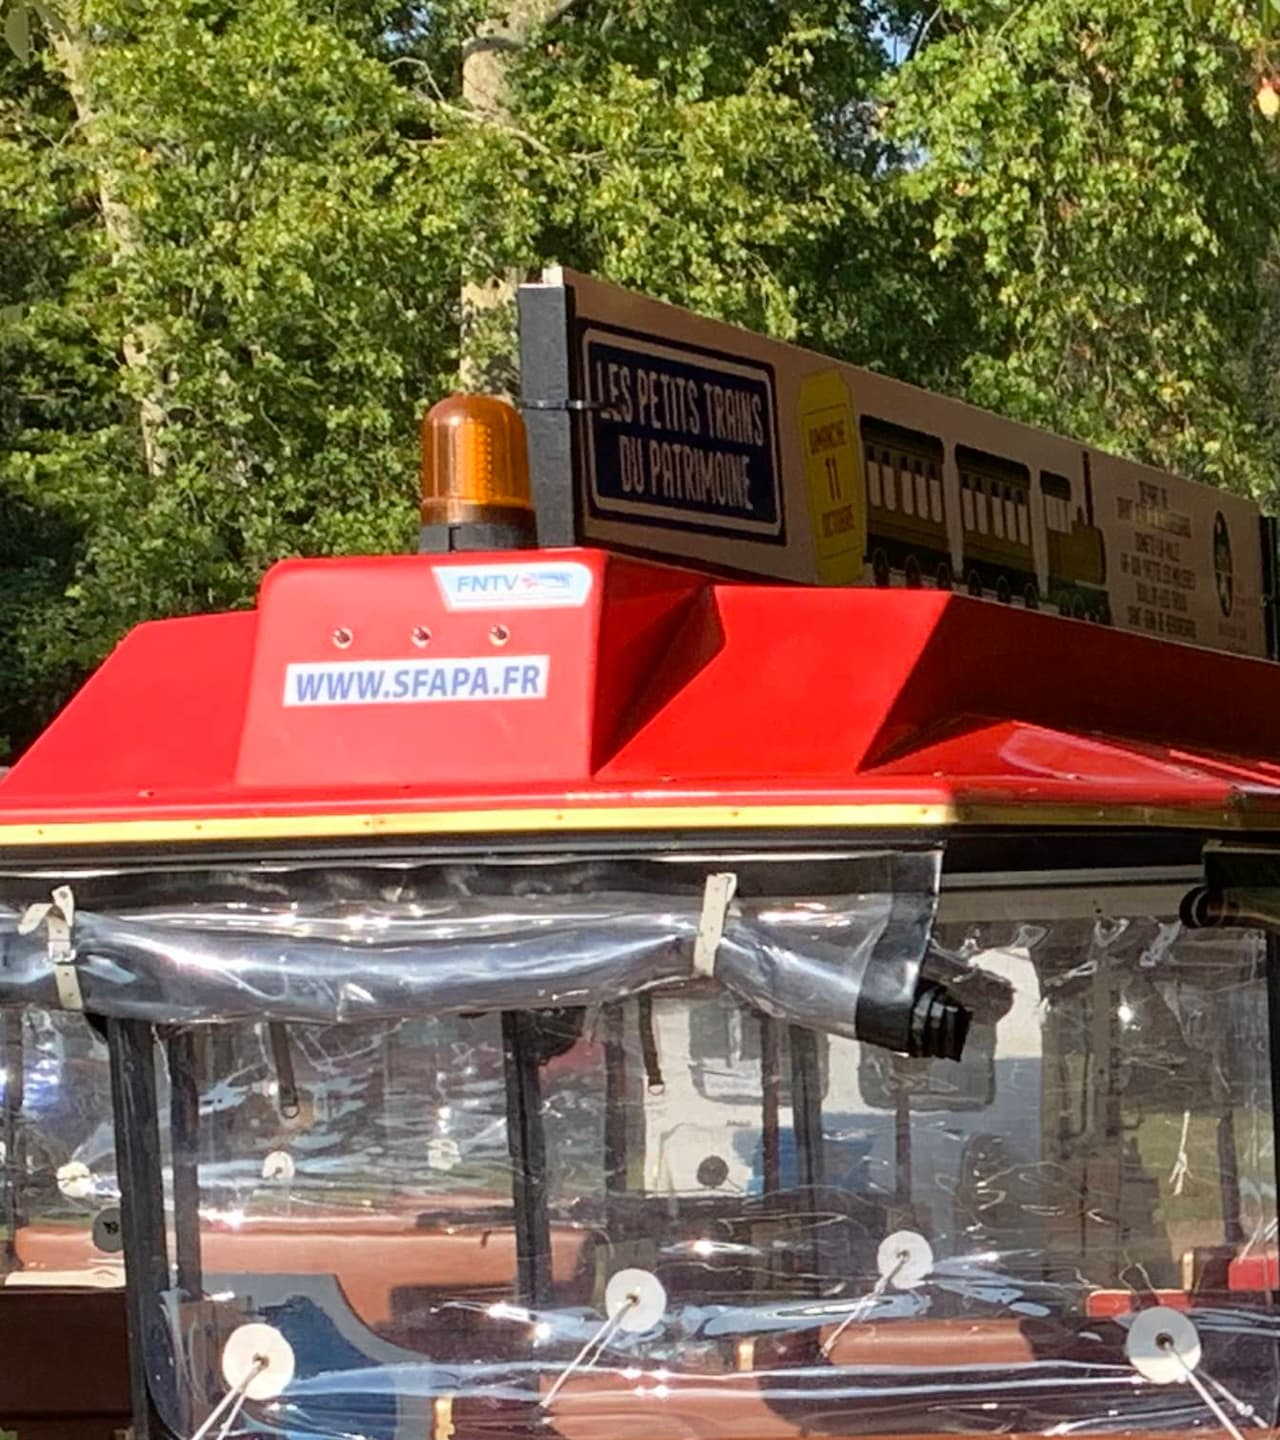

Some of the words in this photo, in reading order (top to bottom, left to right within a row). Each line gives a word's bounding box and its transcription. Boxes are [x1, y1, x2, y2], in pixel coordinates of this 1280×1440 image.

[595, 359, 633, 423] LES
[637, 368, 700, 435] PETITS
[703, 382, 764, 447] TRAINS
[618, 434, 644, 494] DU
[649, 439, 753, 510] PATRIMOINE
[825, 456, 842, 502] 11
[457, 574, 519, 592] FNTV
[295, 664, 540, 702] WWW.SFAPA.FR
